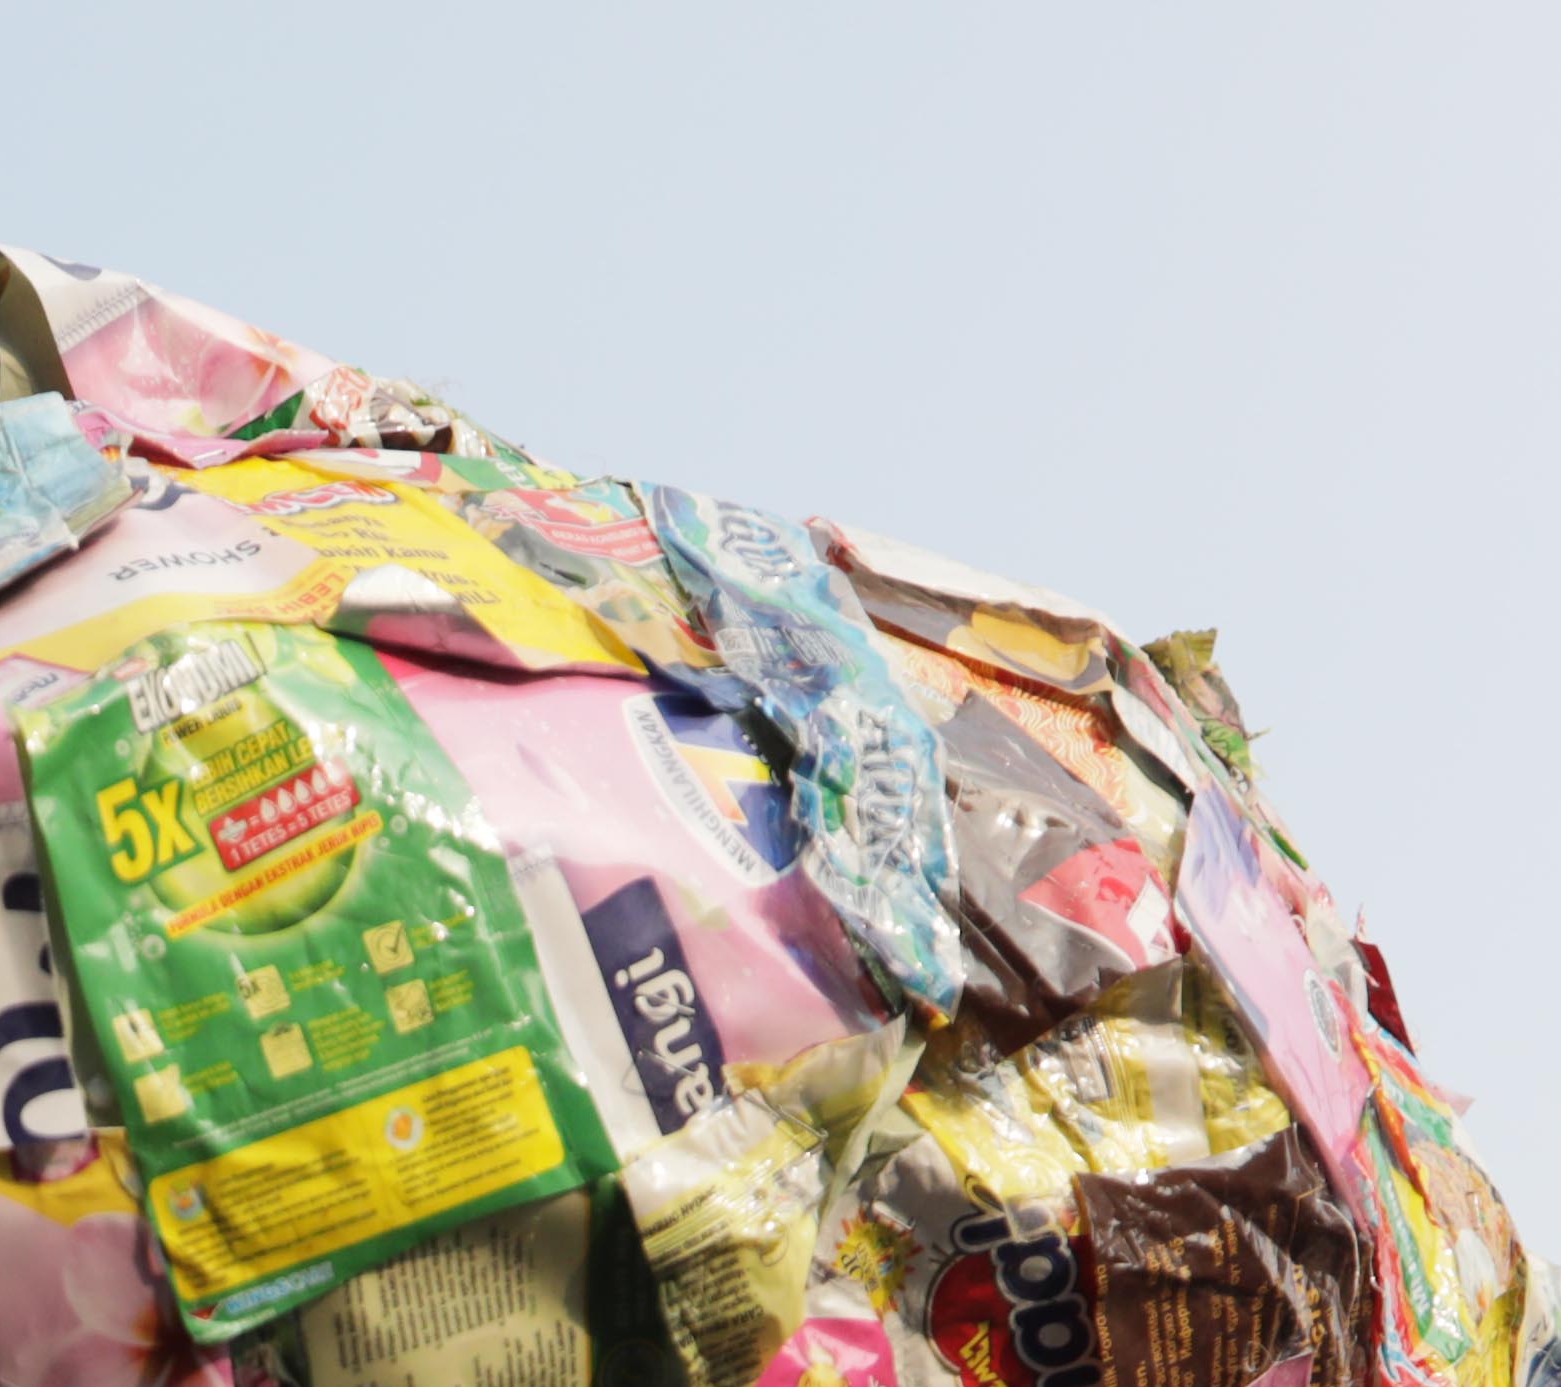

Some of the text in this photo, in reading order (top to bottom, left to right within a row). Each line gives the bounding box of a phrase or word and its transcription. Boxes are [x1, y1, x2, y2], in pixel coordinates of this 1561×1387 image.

[109, 538, 262, 586] SHOWER
[233, 720, 294, 768] CEPAT
[633, 703, 759, 874] MENGHILANGKAN
[241, 824, 287, 861] TETES
[309, 791, 355, 828] TETES
[614, 944, 716, 1116] angi
